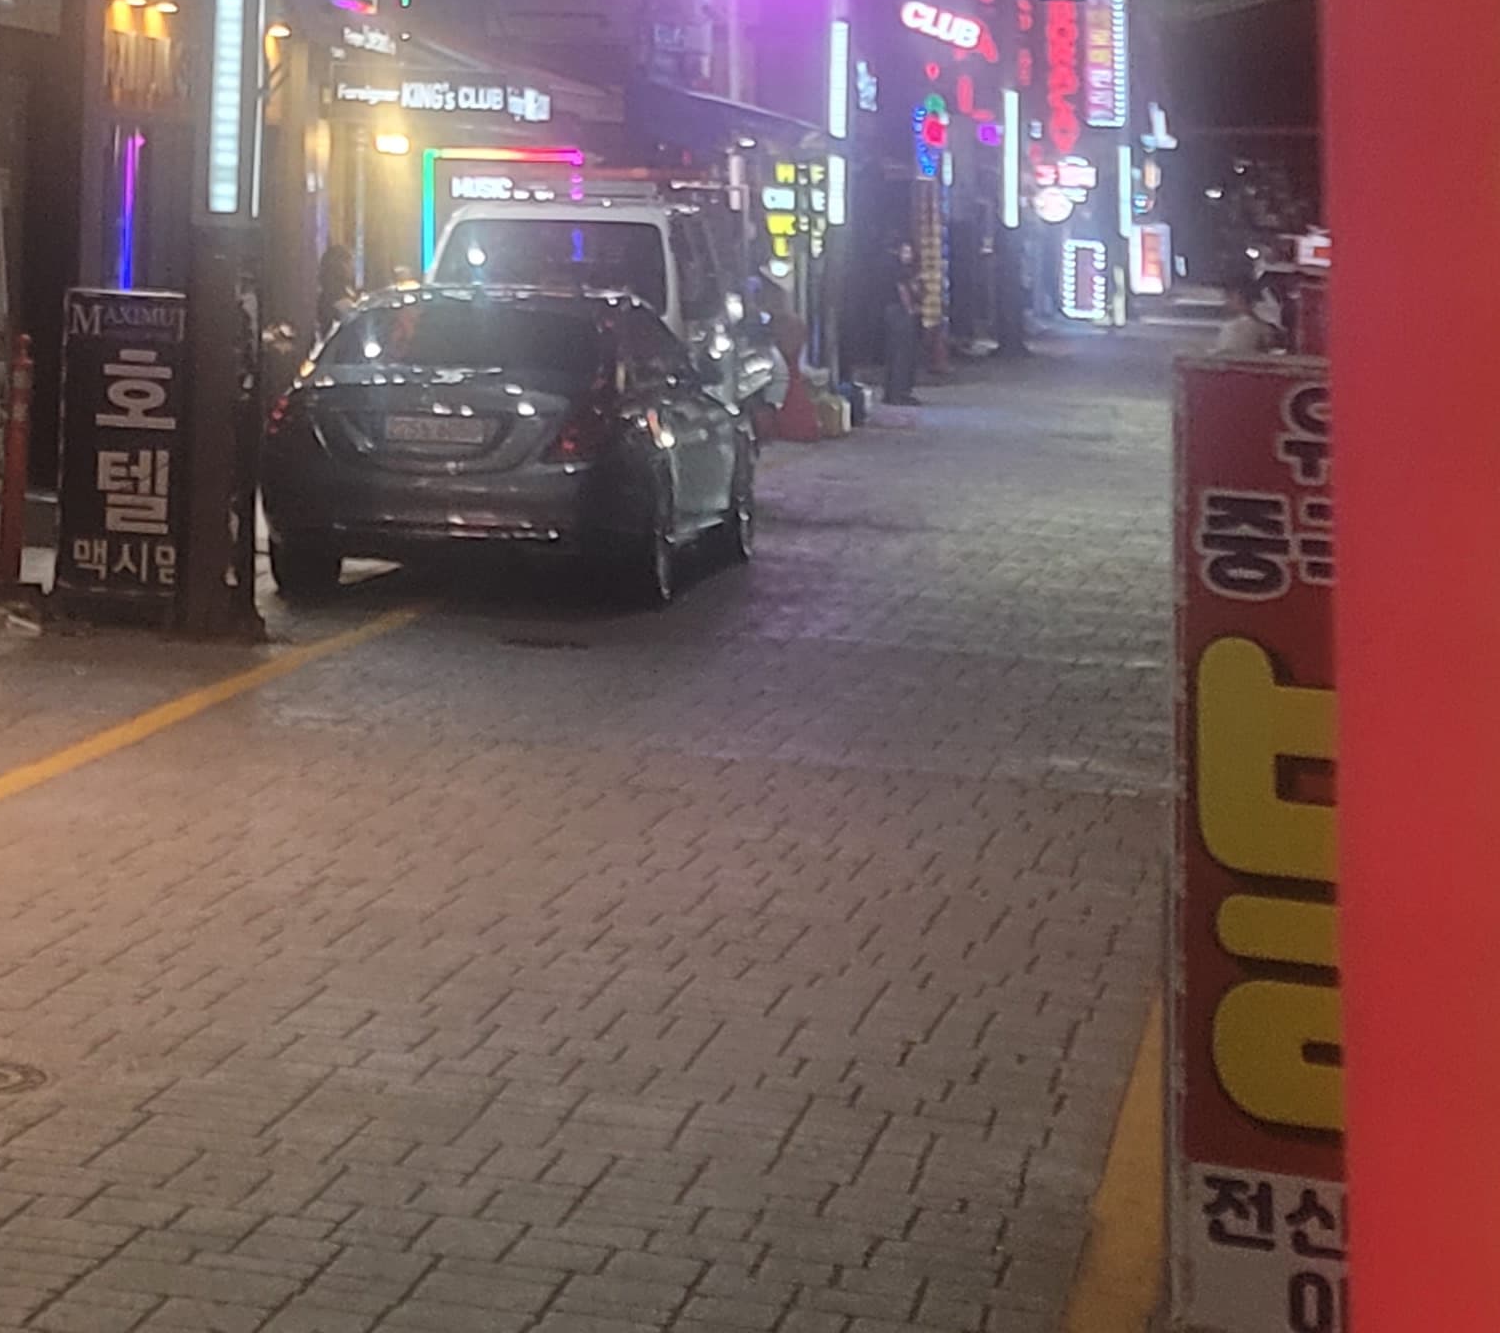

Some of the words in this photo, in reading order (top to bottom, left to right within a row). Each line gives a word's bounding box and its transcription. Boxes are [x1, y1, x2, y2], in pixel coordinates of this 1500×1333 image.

[901, 1, 981, 48] CLUB
[457, 85, 504, 112] CLUB
[71, 303, 187, 343] MAXIMU
[94, 347, 178, 535] 호텔
